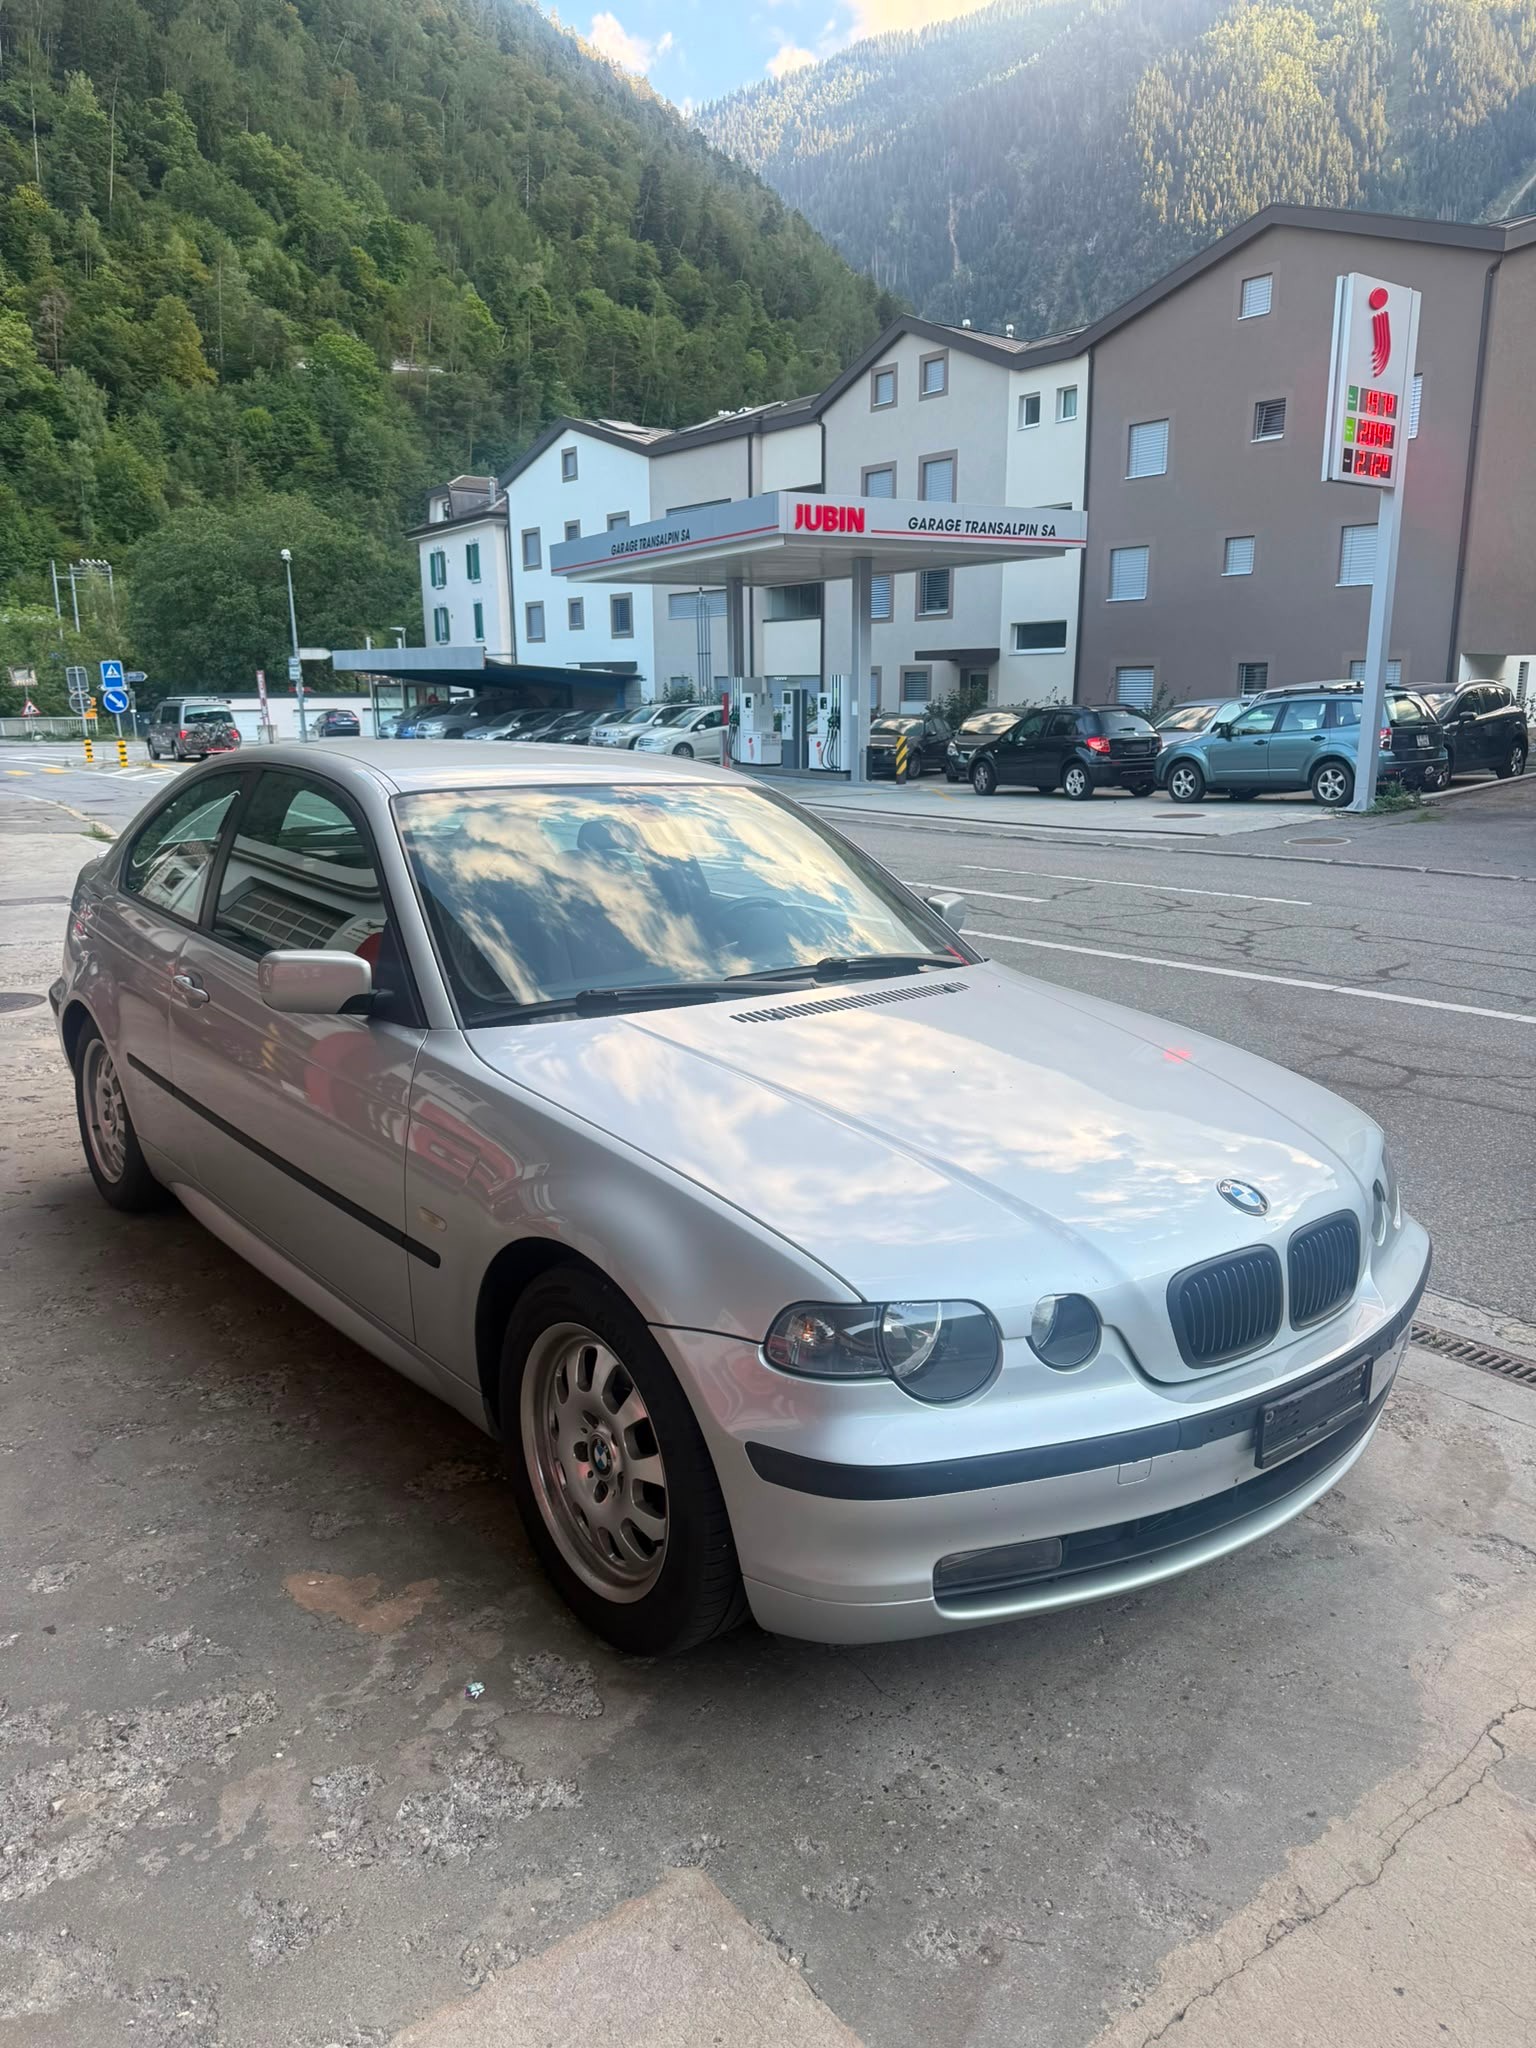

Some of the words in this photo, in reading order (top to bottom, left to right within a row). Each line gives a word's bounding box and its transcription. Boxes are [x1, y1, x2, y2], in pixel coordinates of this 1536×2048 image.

[795, 503, 865, 533] JUBIN
[908, 517, 962, 532] GARAGE
[965, 520, 1038, 537] TRANSALPIN
[1041, 524, 1056, 537] SA
[611, 540, 638, 556] GARAGE
[640, 530, 680, 550] TRANSALPIN
[681, 528, 691, 542] SA
